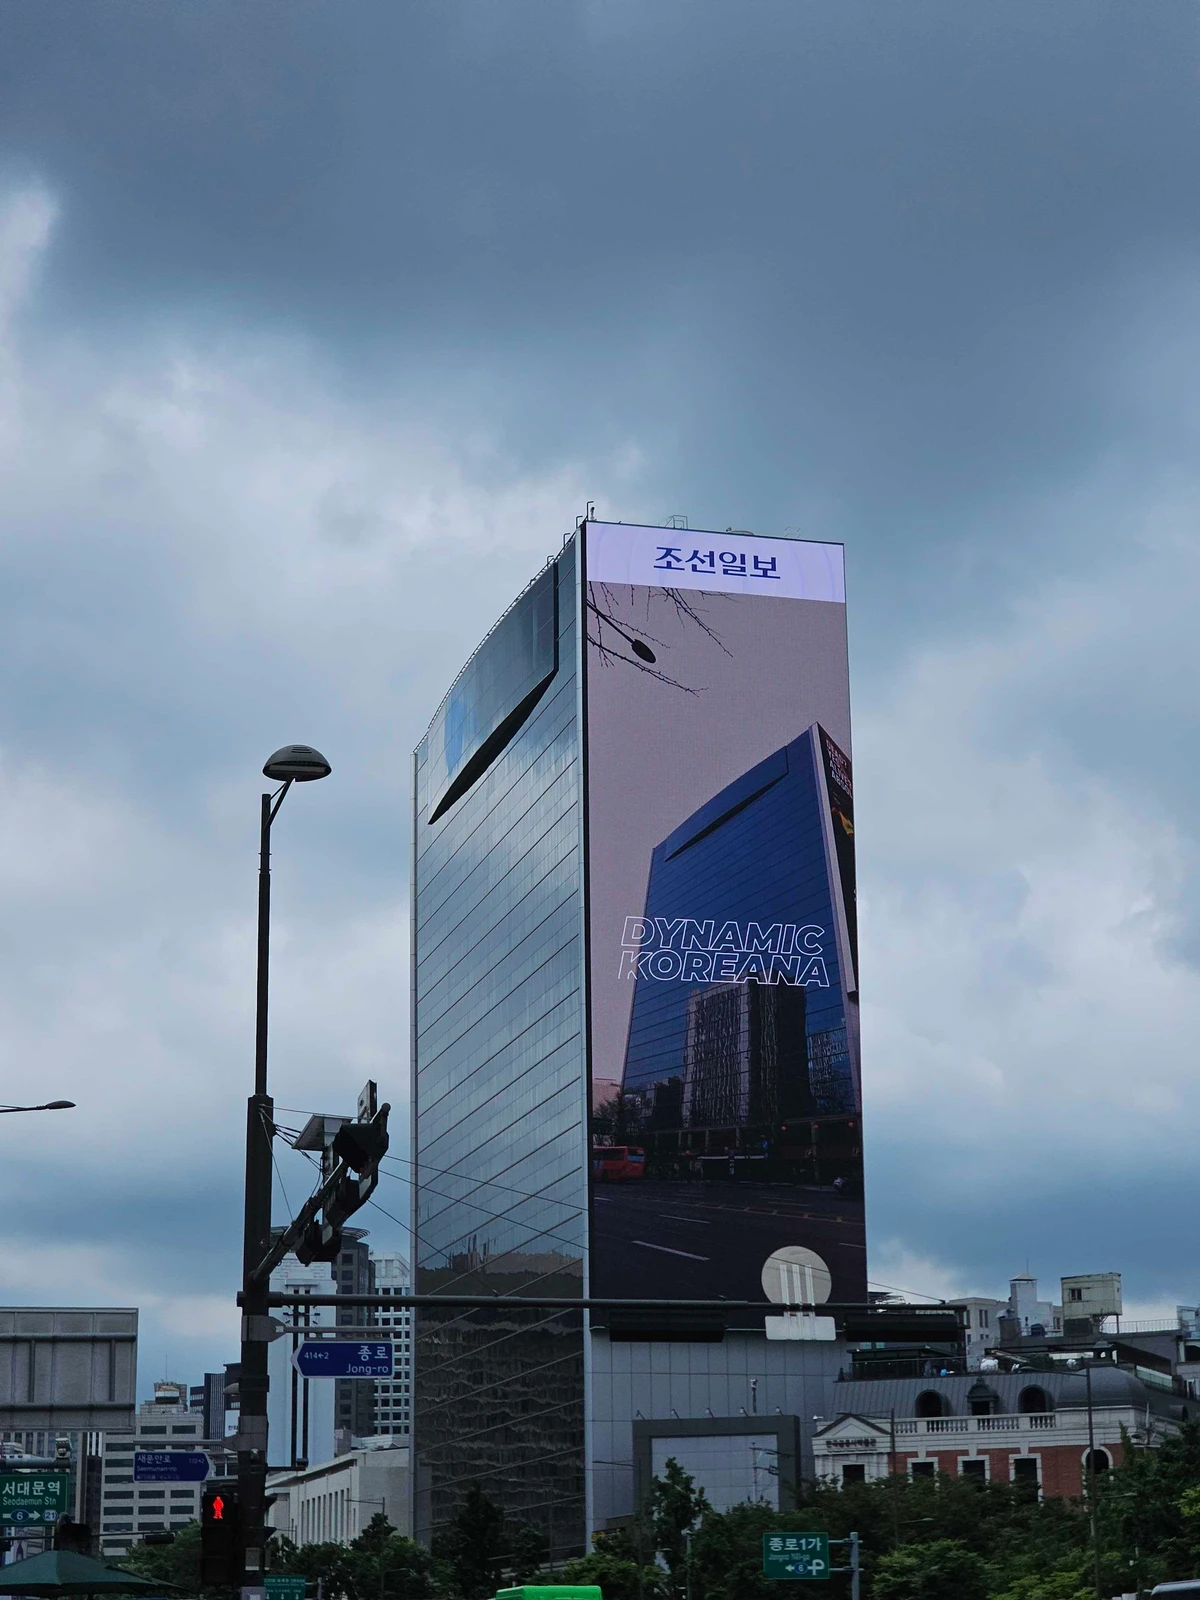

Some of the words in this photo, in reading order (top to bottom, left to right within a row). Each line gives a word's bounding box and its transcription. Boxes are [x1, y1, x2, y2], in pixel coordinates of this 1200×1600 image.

[653, 546, 781, 579] 조선일보
[621, 916, 825, 956] DYNAMIC
[618, 949, 830, 987] KOREANA
[357, 1345, 388, 1361] 종로
[346, 1364, 389, 1375] Jong-ro
[138, 1455, 171, 1464] 새문안로
[2, 1481, 60, 1496] 서대문역
[3, 1496, 42, 1506] Seodaemun
[44, 1496, 57, 1506] Stn
[16, 1511, 24, 1520] 6
[45, 1511, 55, 1519] 21
[768, 1537, 822, 1551] 종로1가
